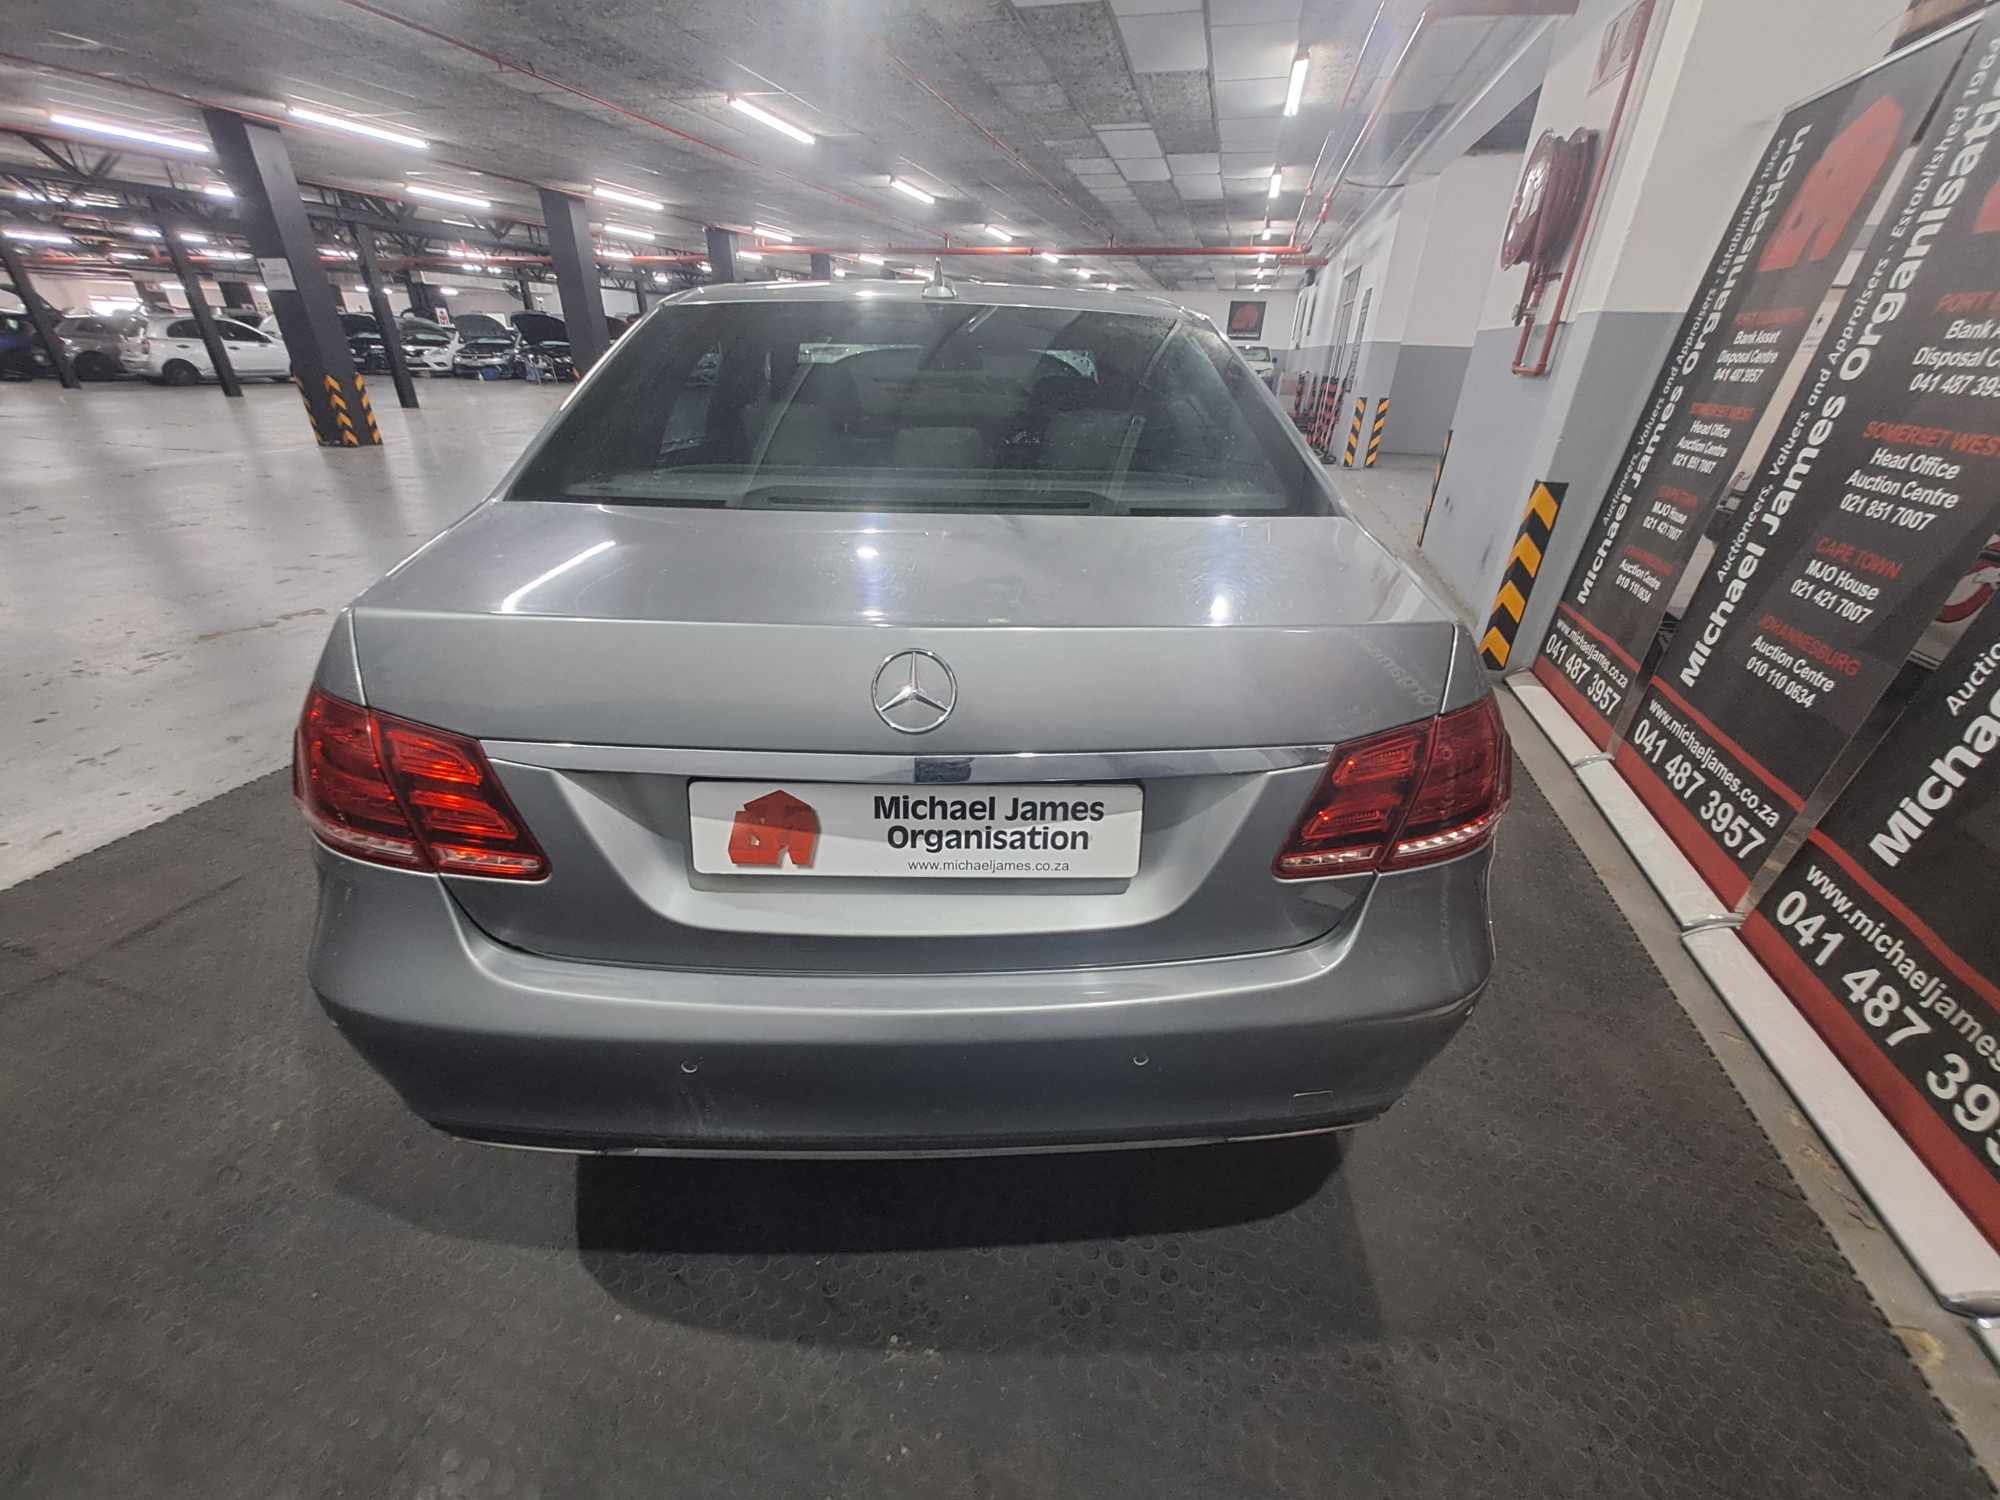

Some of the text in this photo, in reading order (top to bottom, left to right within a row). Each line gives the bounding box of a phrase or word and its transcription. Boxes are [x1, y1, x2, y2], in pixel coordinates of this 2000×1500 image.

[1637, 396, 1664, 445] Valuers
[1663, 367, 1676, 395] and
[1716, 184, 1763, 274] Established
[1944, 318, 1994, 339] Bank
[1577, 493, 1632, 605] Michael
[1632, 385, 1683, 489] James
[1682, 124, 1813, 375] Organisation
[1716, 483, 1774, 584] Auctioneers,
[1768, 409, 1810, 477] Valuers
[1808, 368, 1831, 406] and
[1828, 256, 1889, 366] Appraisers
[1891, 104, 1970, 238] Established
[1911, 346, 1990, 371] Disposal
[1908, 372, 1943, 392] 041
[1939, 373, 1976, 395] 487
[1862, 420, 1952, 448] SOMERSET
[1869, 447, 1961, 480] Head Office
[1845, 469, 1960, 509] Auction Centre
[1840, 493, 1938, 532] 021 851 7007
[1679, 541, 1766, 688] Michael
[1761, 395, 1846, 537] James
[1804, 559, 1881, 601] MJO House
[1856, 550, 1904, 580] TOWN
[1790, 578, 1873, 624] 021 421 7007
[1546, 634, 1622, 715] 041 487 3957
[1746, 656, 1817, 708] 010 110 0634
[1751, 635, 1835, 693] Auction Centre
[1648, 698, 1780, 828] www.michaeljames.co.za
[873, 794, 1105, 822] Michael James
[1634, 718, 1767, 859] 041 487 3957
[886, 823, 1089, 852] Organisation
[908, 859, 1070, 873] www.michaeljames.co.za
[1776, 889, 1845, 967] 041
[1841, 967, 1932, 1048] 487
